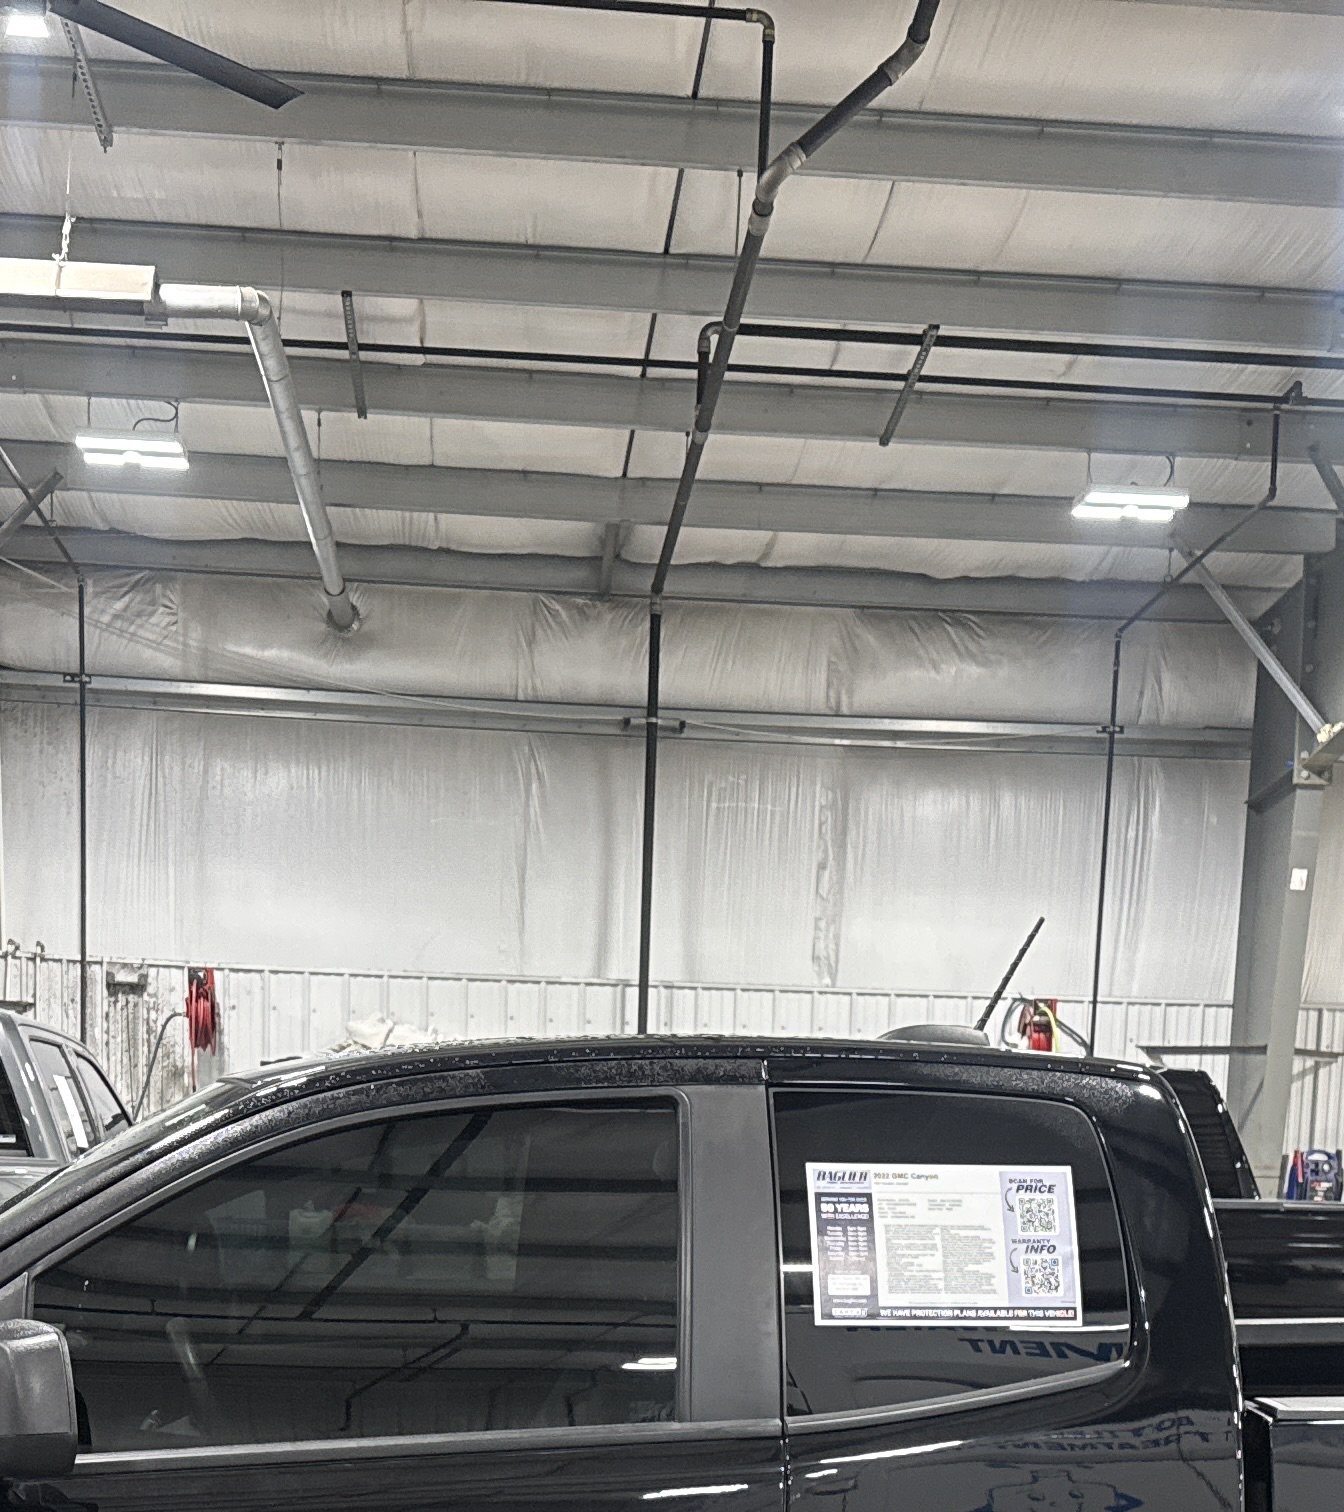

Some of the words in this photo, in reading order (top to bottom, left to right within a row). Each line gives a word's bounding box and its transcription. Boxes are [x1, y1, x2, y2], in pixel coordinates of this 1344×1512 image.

[891, 1172, 909, 1180] GMC
[910, 1172, 939, 1181] Canyon
[1015, 1184, 1057, 1194] PRICE
[836, 1203, 870, 1213] YEARS
[1024, 1244, 1057, 1255] INFO
[892, 1308, 911, 1317] HAVE
